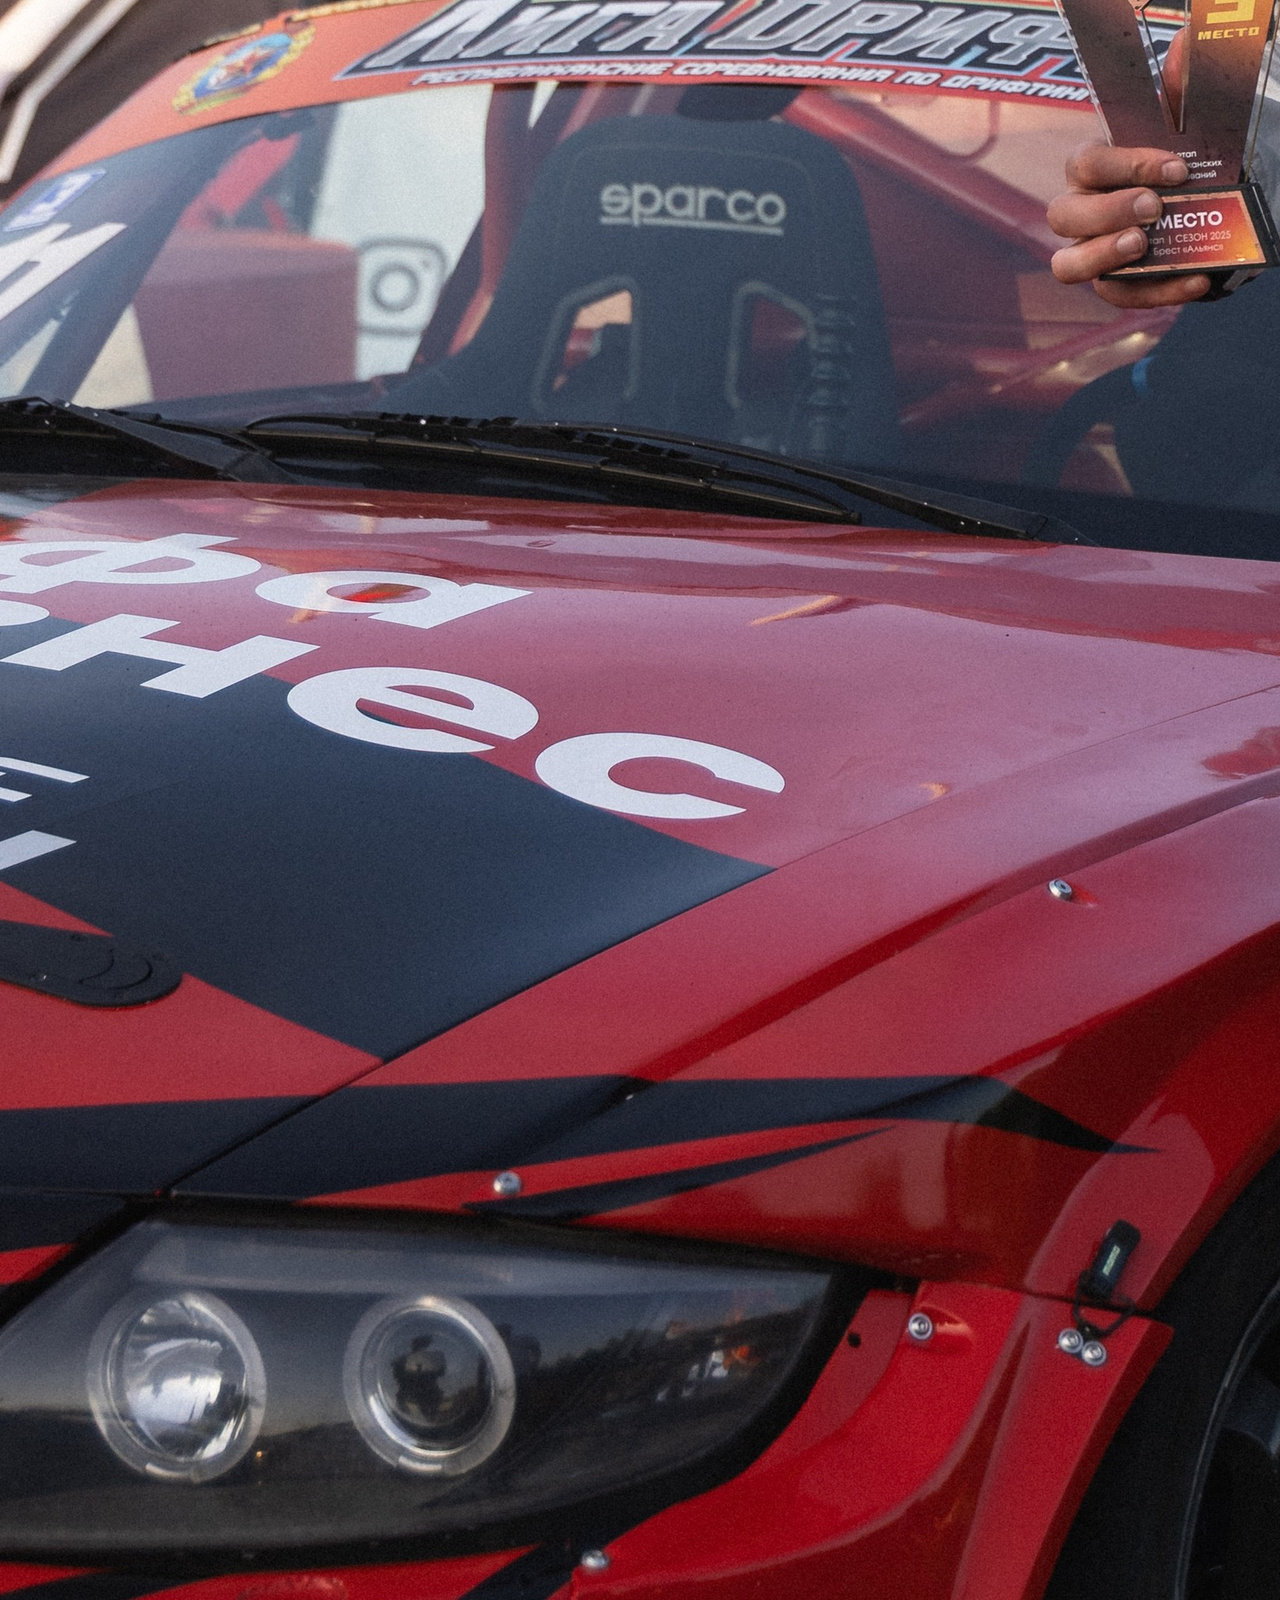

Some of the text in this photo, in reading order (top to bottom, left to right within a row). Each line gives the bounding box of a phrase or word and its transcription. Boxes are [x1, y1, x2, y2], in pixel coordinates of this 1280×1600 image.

[1198, 26, 1260, 41] МЕСТО
[672, 61, 896, 82] СОРЕВНОВАНИЯ
[893, 70, 942, 86] ПО
[941, 74, 1094, 102] ДРИФТИН
[600, 182, 787, 231] sparco
[1155, 210, 1223, 230] МЕСТО
[1175, 233, 1208, 243] СЕЗОН
[1210, 230, 1232, 240] 2025
